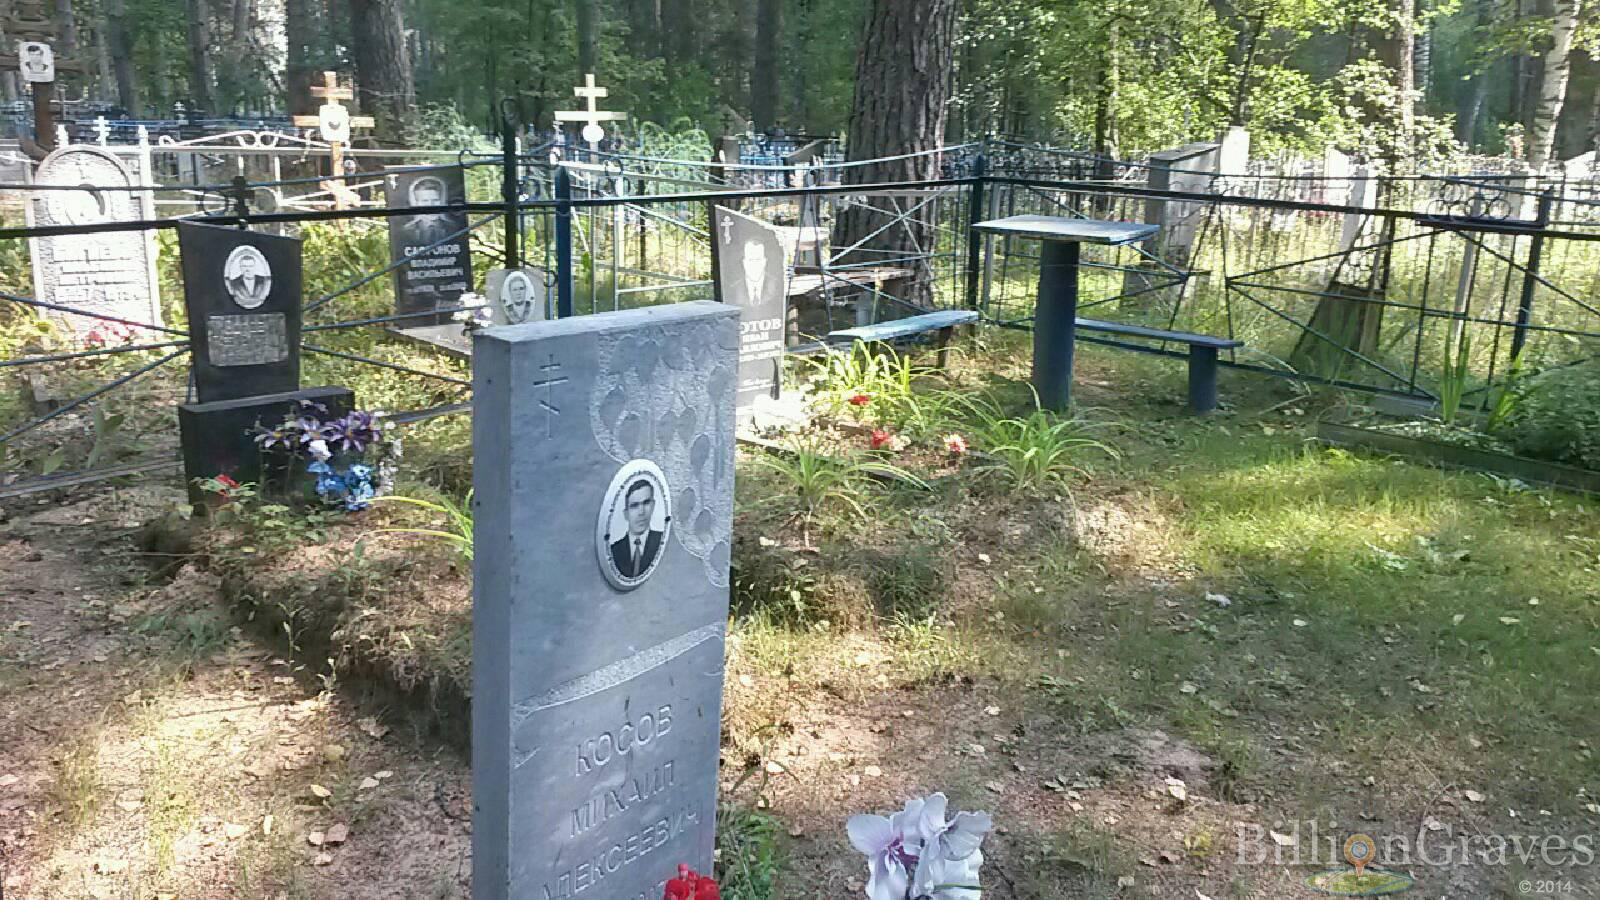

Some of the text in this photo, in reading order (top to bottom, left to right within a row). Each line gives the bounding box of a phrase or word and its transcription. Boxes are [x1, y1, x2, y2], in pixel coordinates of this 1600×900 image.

[404, 244, 461, 257] САОНОВ
[739, 318, 782, 335] ОТОВ
[575, 704, 672, 777] КОСОВ
[570, 759, 675, 838] МИХАИЛ
